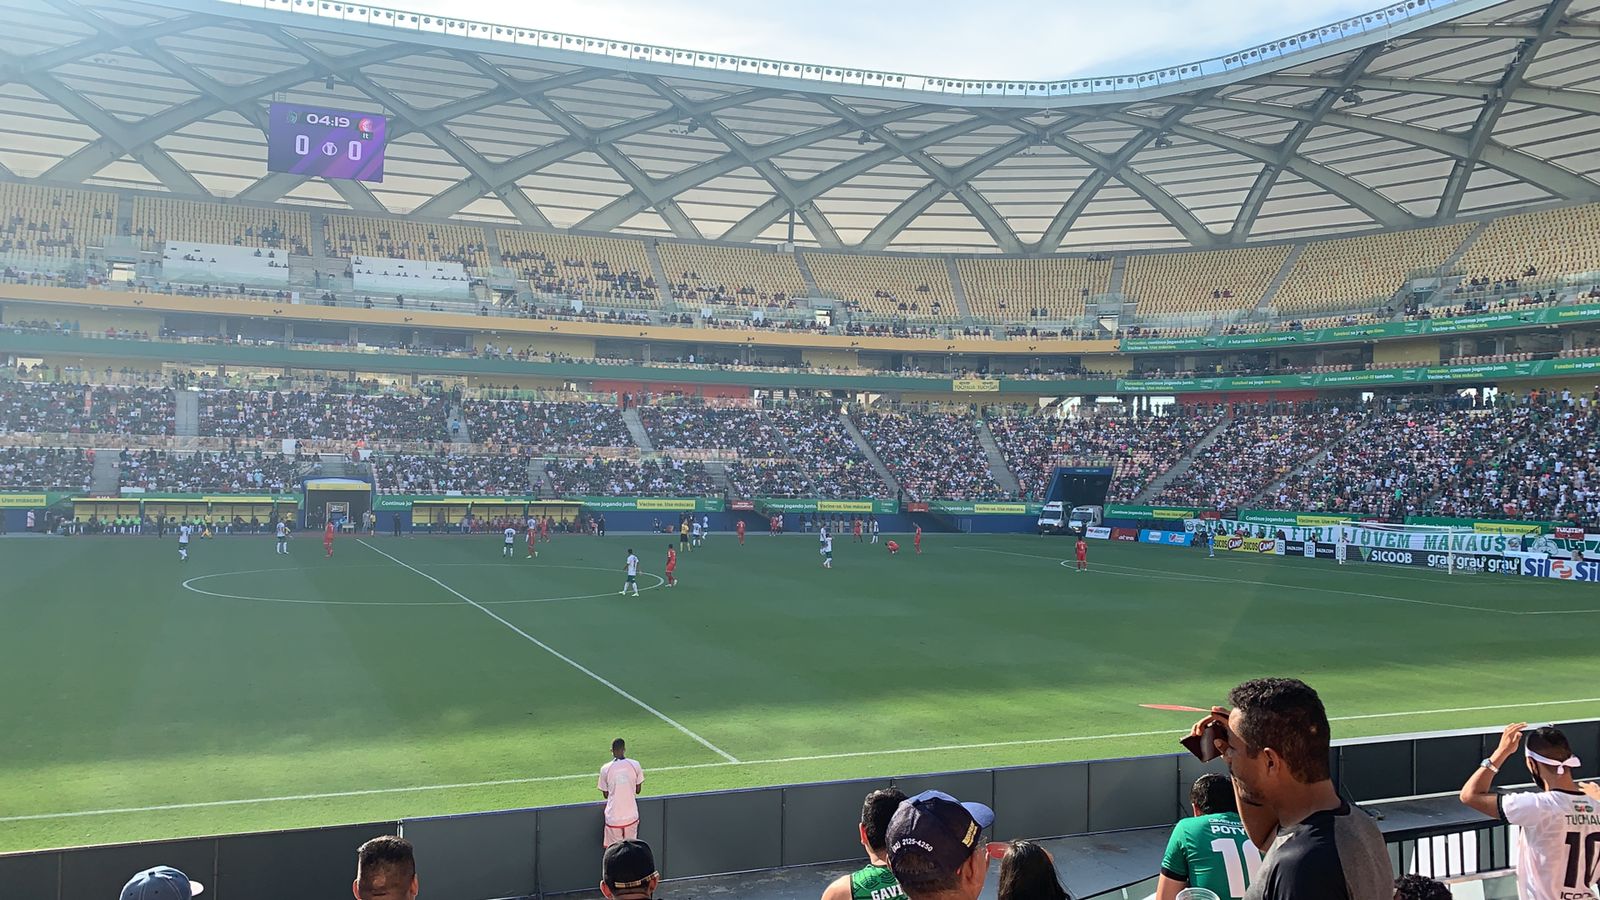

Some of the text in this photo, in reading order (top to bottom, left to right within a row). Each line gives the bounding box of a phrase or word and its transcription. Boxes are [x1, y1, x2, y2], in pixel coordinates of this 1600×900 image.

[306, 113, 350, 128] 04:19
[295, 134, 361, 160] 0 0
[1228, 539, 1242, 549] CAMP
[1243, 541, 1258, 550] SUCOS
[1260, 541, 1274, 551] CAMP
[1351, 528, 1411, 548] JOVEM
[1423, 535, 1506, 552] MANAUS
[1371, 550, 1412, 563] SICOOB
[1525, 558, 1551, 577] Sil
[1211, 825, 1245, 835] POTY
[902, 838, 933, 852] 2125-4250
